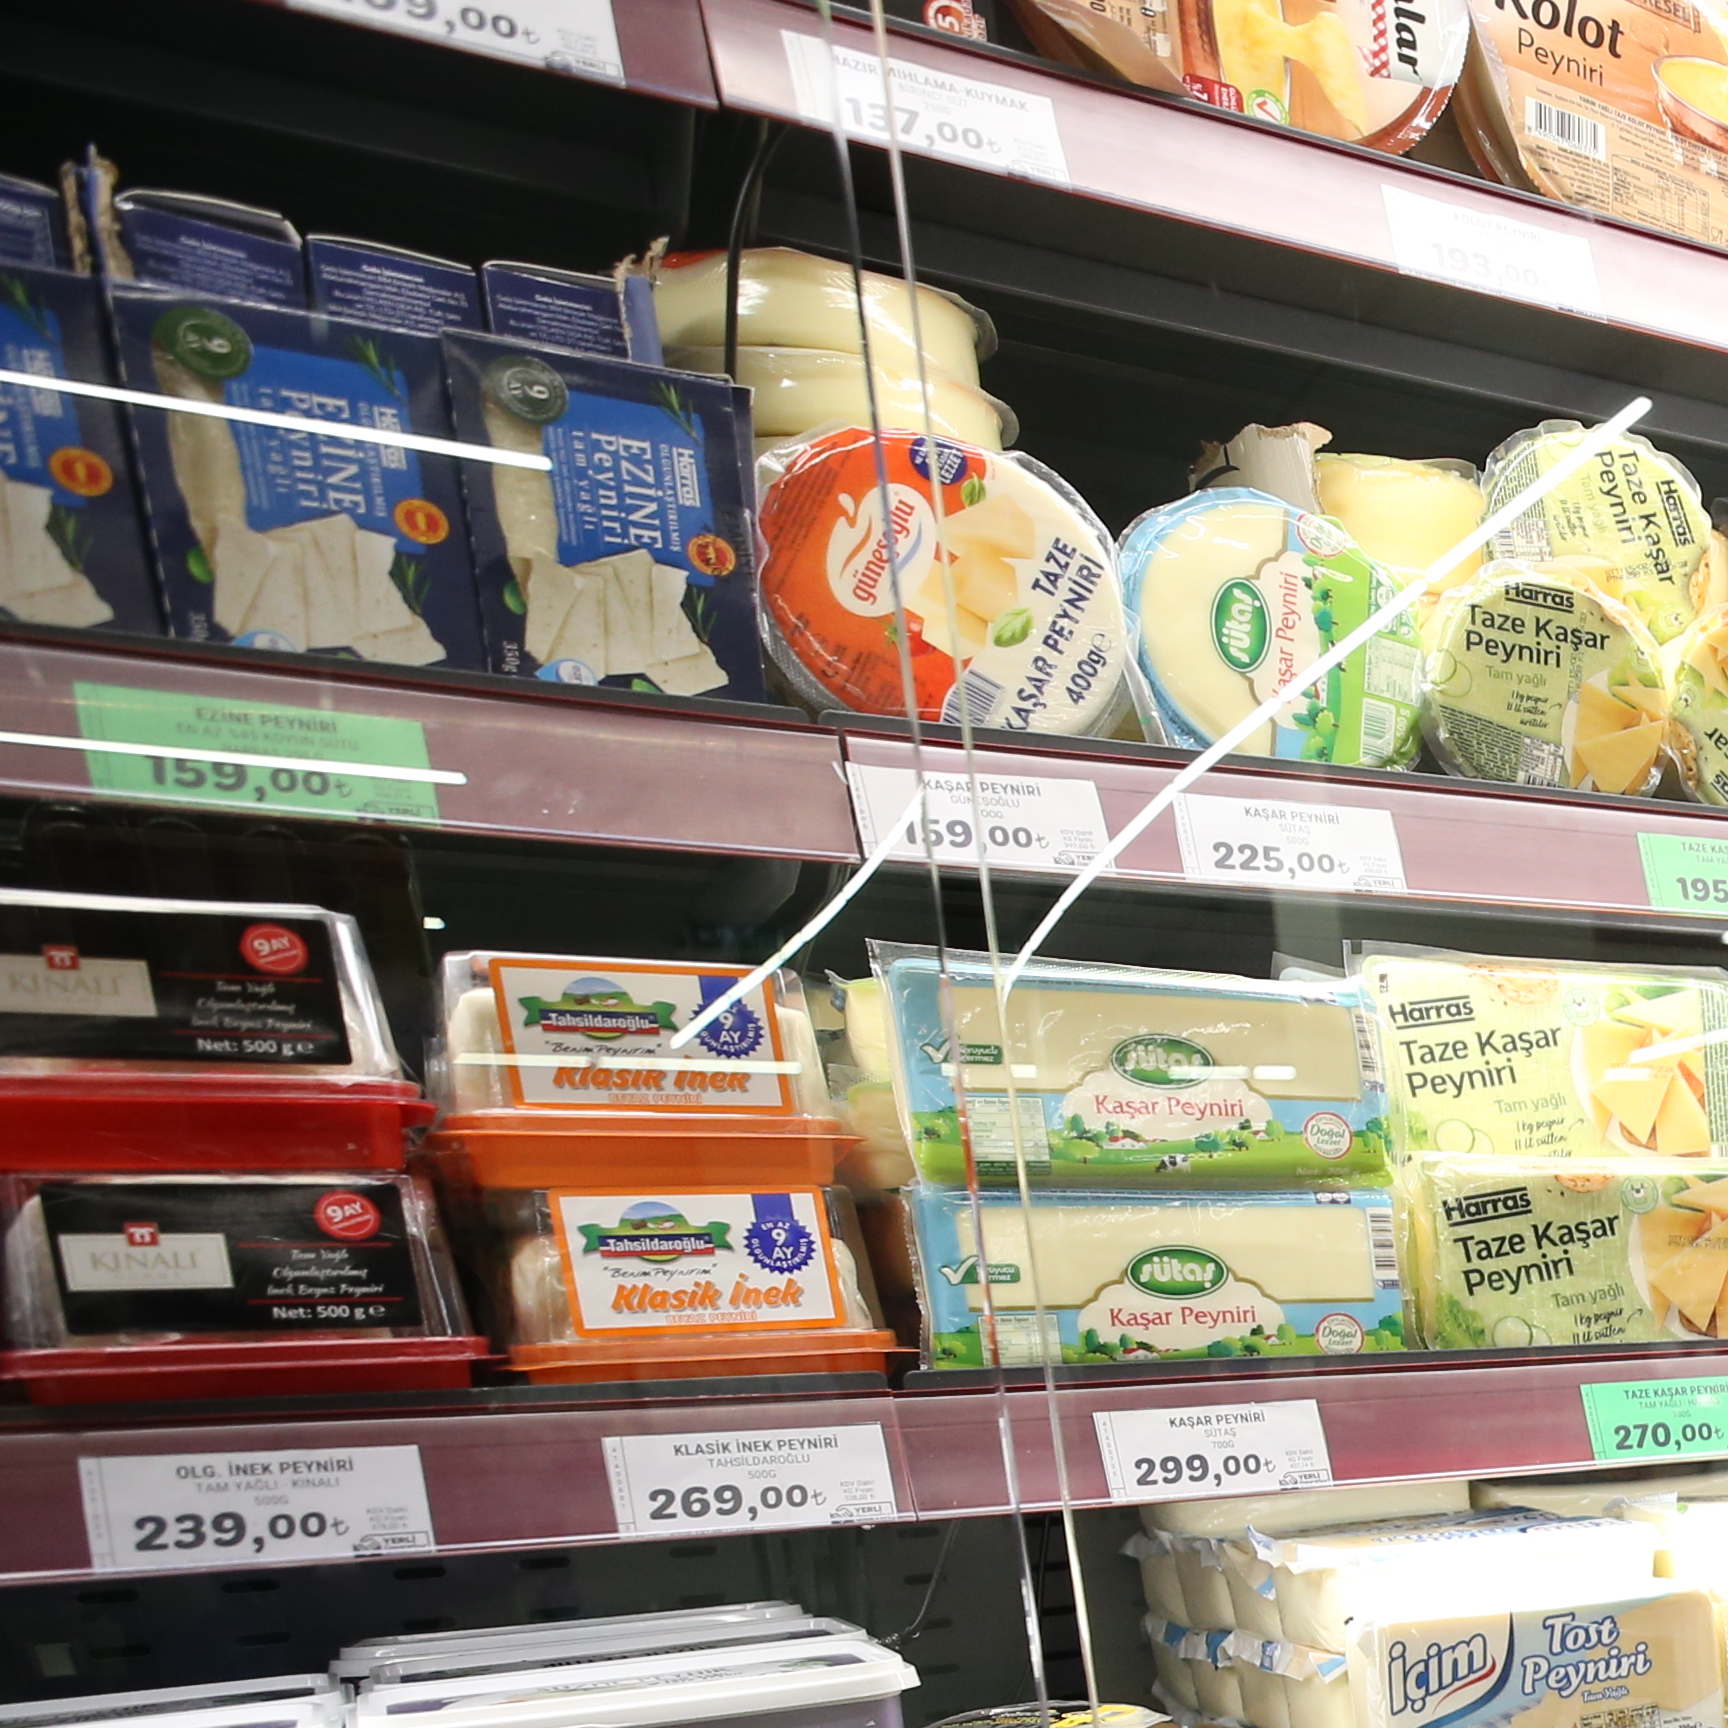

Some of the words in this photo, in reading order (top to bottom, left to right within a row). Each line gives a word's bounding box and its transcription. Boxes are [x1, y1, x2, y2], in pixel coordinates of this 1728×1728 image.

[1517, 26, 1606, 89] Peyniri
[618, 435, 663, 550] EZİNE
[1618, 449, 1651, 505] Taze
[1641, 506, 1677, 586] Kaşar
[850, 498, 916, 605] güneşoğlu
[1030, 536, 1078, 597] TAZE
[1464, 603, 1527, 638] Taze
[1532, 611, 1610, 656] Kaşar
[1462, 629, 1564, 671] Peyniri
[1242, 804, 1284, 822] KAŞAR
[1287, 808, 1341, 827] PEYNİRİ
[547, 1012, 650, 1031] Tahsildaroğlu
[1399, 1034, 1469, 1067] Taze
[1478, 1022, 1562, 1064] Kaşar
[1405, 1059, 1519, 1098] Peyniri
[1092, 1092, 1161, 1120] Kaşar
[1164, 1095, 1246, 1121] Peyniri
[1309, 1128, 1348, 1146] Doğal
[606, 1234, 707, 1253] Tahsildaroğlu
[1453, 1231, 1526, 1266] Taze
[1532, 1211, 1620, 1254] Kaşar
[1136, 1254, 1217, 1288] sütaş
[612, 1283, 723, 1314] Klasik
[729, 1273, 804, 1308] İnek
[1109, 1304, 1175, 1330] Kaşar
[1179, 1304, 1258, 1329] Peyniri
[1622, 1386, 1652, 1399] TAZE
[1654, 1382, 1689, 1399] KAŞAR
[1168, 1413, 1213, 1430] KAŞAR
[1216, 1409, 1266, 1428] PEYNİRİ
[672, 1439, 731, 1458] KLASİK
[733, 1437, 773, 1455] İNEK
[776, 1433, 840, 1453] PEYNİRİ
[175, 1462, 222, 1482] OLG.
[225, 1458, 267, 1479] İNEK
[270, 1454, 355, 1477] PEYNİRİ
[1542, 1613, 1621, 1656] Tost
[1386, 1633, 1491, 1718] İçim
